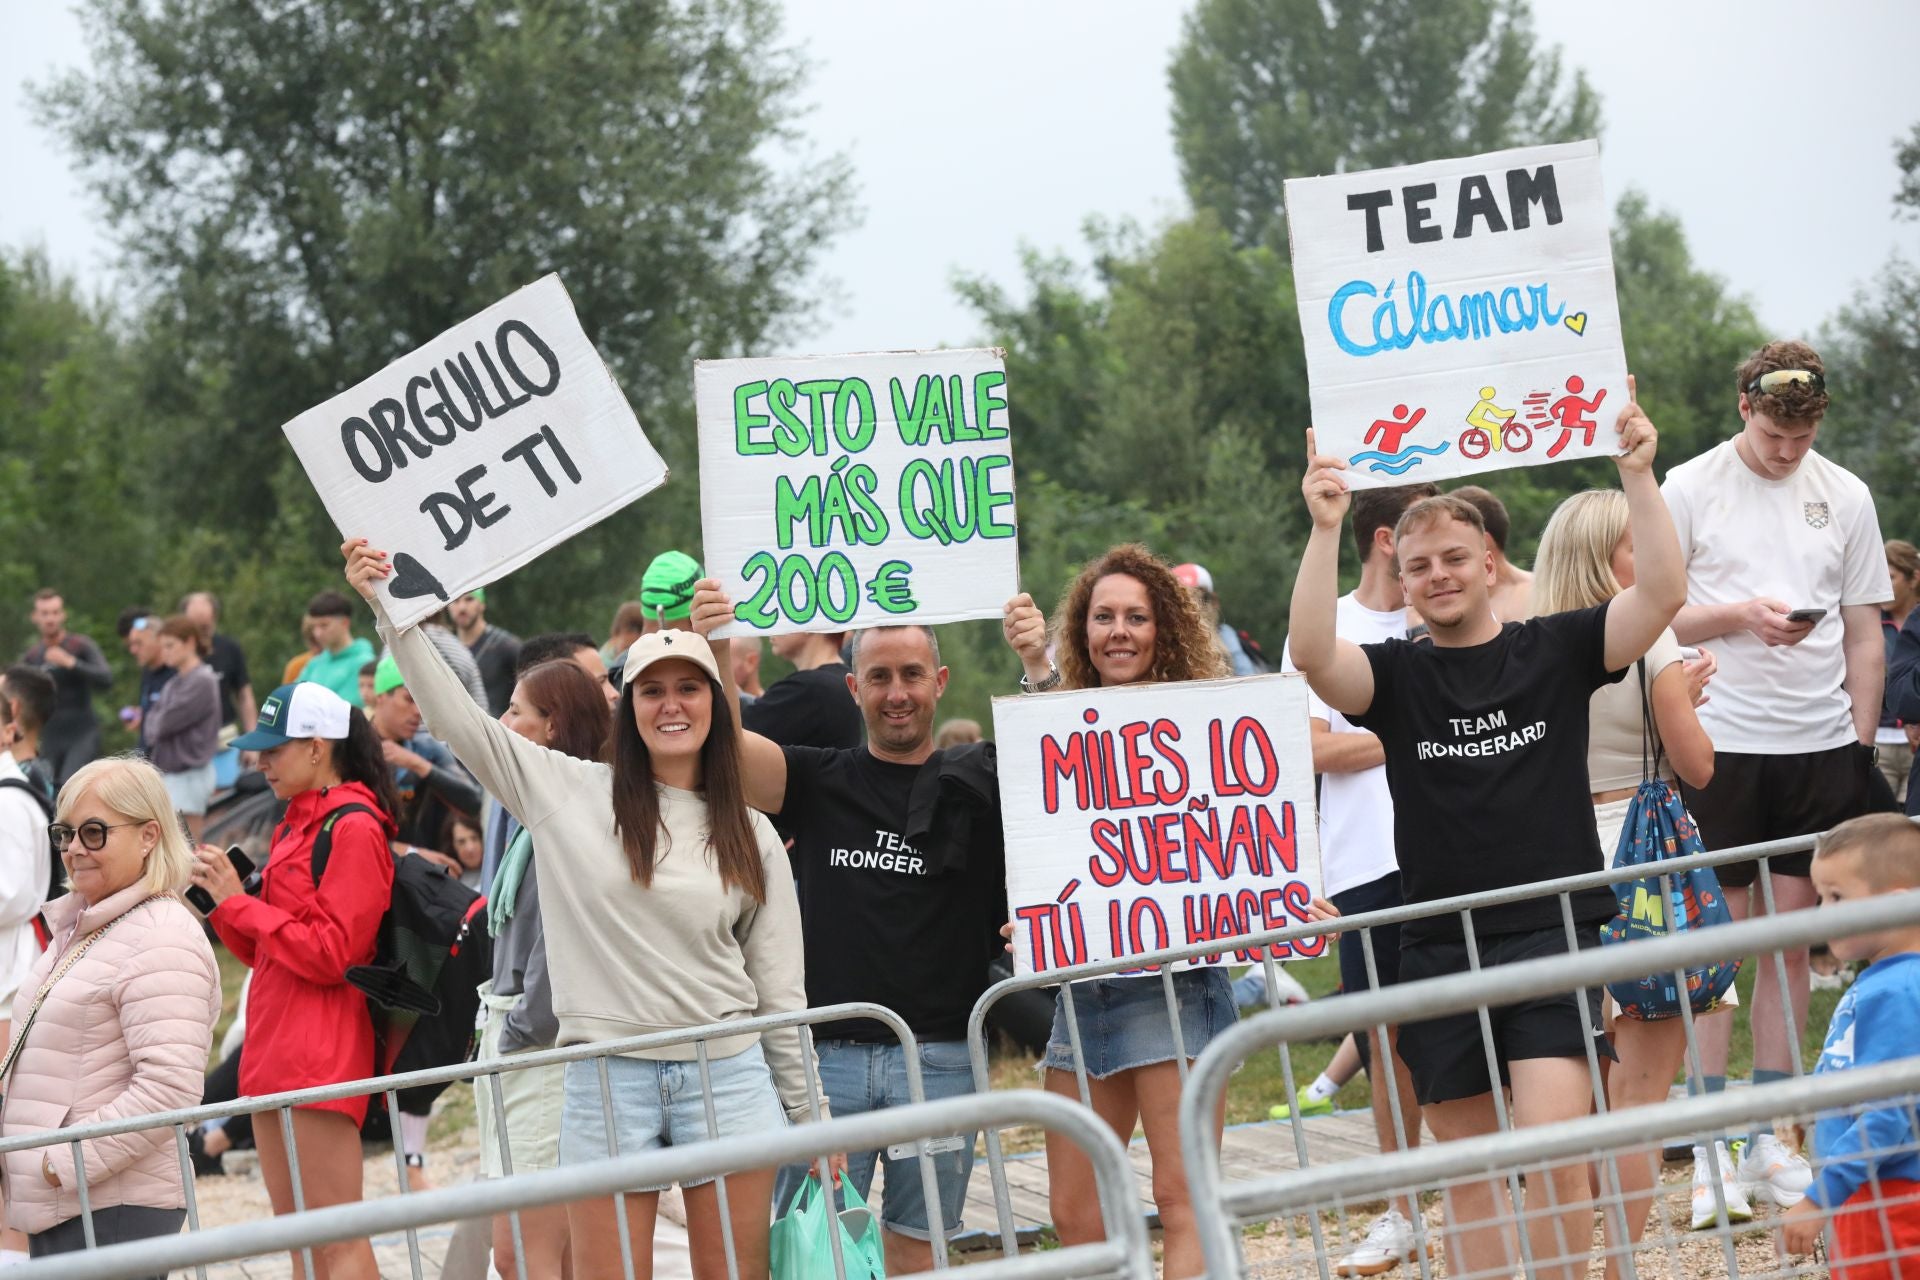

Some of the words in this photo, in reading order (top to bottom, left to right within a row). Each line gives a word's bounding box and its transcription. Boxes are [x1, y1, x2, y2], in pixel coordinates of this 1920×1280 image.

[1346, 164, 1563, 253] TEAM
[1328, 270, 1566, 357] Cálamar
[341, 319, 561, 484] ORGULLO
[734, 377, 876, 457] ESTO
[889, 371, 1009, 447] VALE
[419, 464, 511, 551] DE
[502, 424, 582, 498] TI
[775, 455, 890, 550] MÁS
[899, 455, 1016, 546] QUE
[734, 551, 860, 629] 200
[866, 560, 920, 614] €
[1208, 716, 1279, 797] LO
[1417, 720, 1547, 761] IRONGERARD
[1449, 709, 1507, 737] TEAM
[830, 848, 927, 875] IRONGER
[876, 829, 922, 854] TEA
[1089, 794, 1298, 887] SUEÑAN
[1015, 879, 1088, 972] TÚ
[1109, 896, 1170, 975] LO
[1183, 880, 1327, 966] HACES
